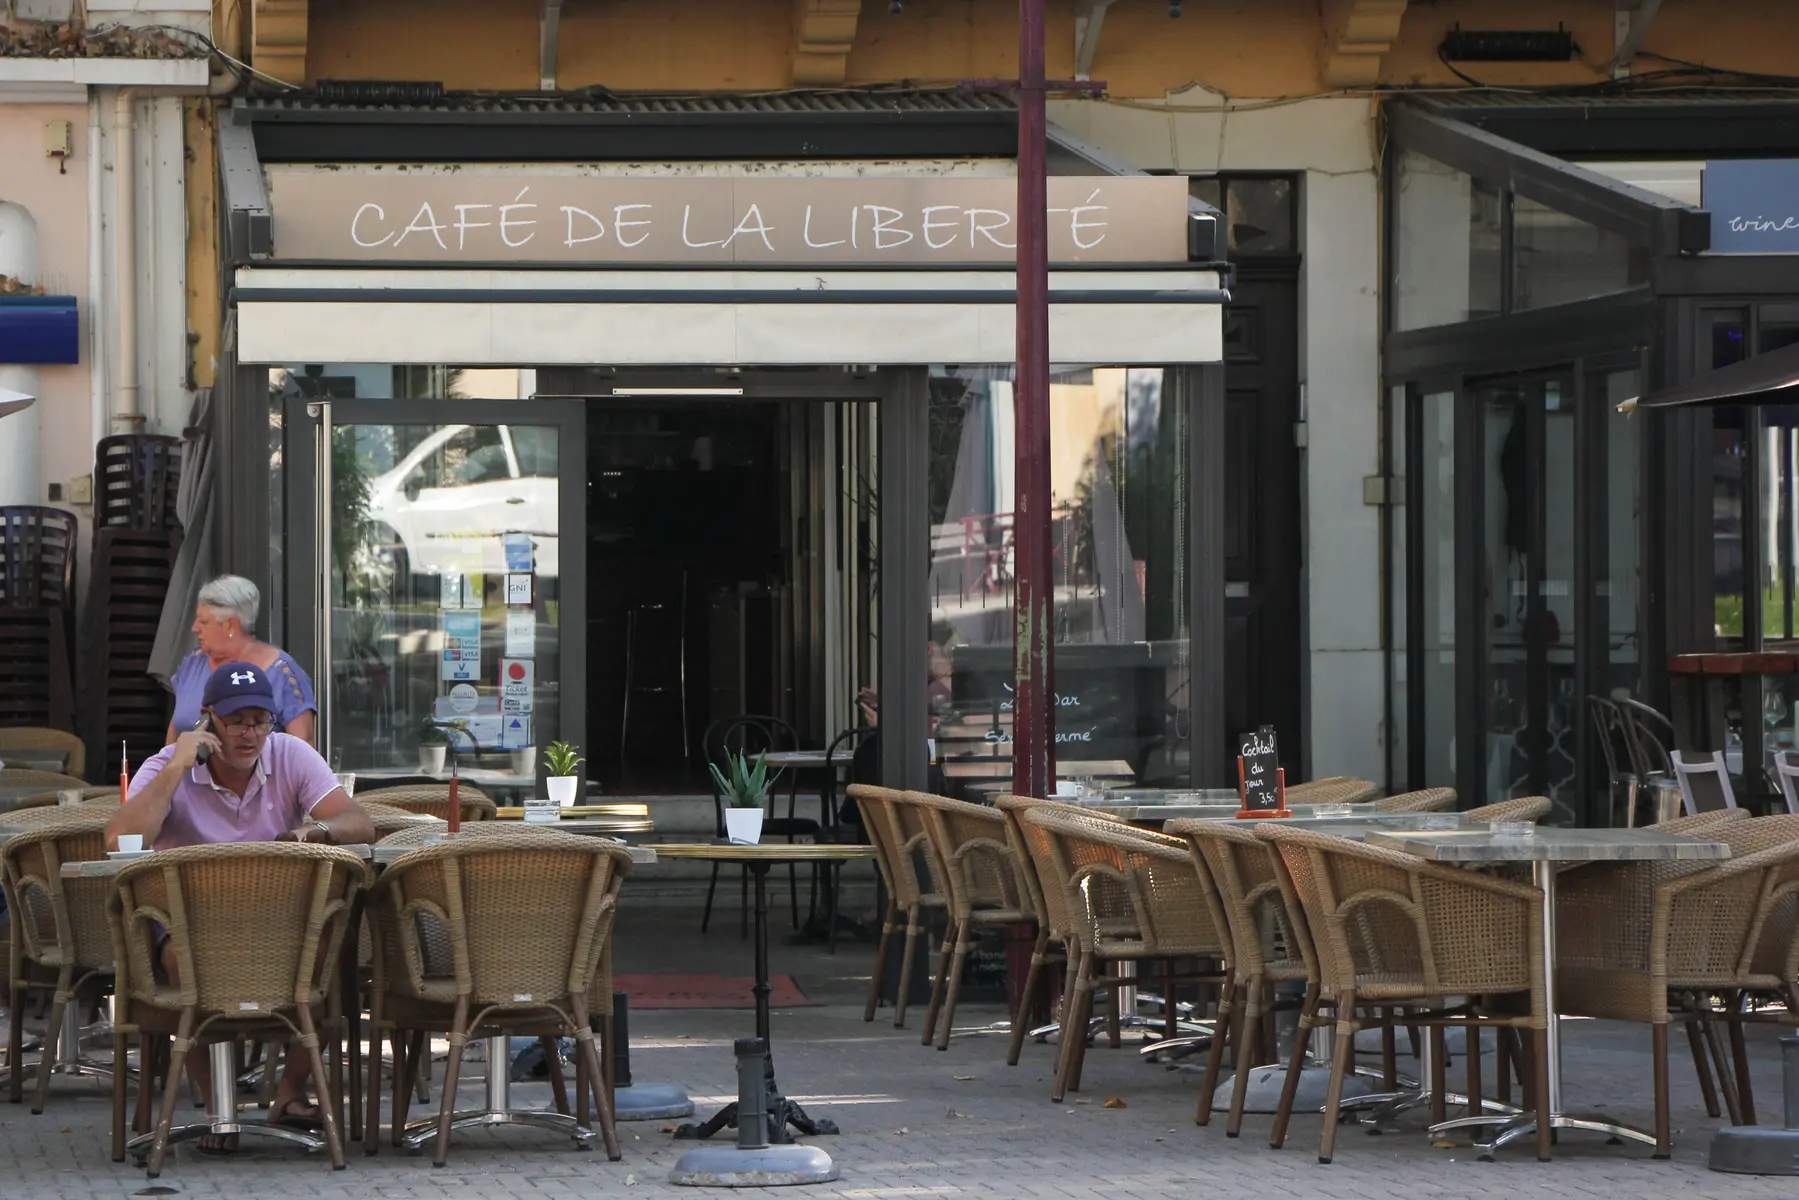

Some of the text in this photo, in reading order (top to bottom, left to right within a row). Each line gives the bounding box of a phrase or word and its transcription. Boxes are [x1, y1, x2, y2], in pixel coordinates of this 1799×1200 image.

[351, 186, 538, 250] CAFÉ
[560, 205, 652, 249] DE
[682, 203, 775, 251] LA
[509, 584, 526, 592] GNI
[505, 684, 528, 692] Ticket
[1242, 734, 1275, 757] Cocktail
[1251, 762, 1264, 775] du
